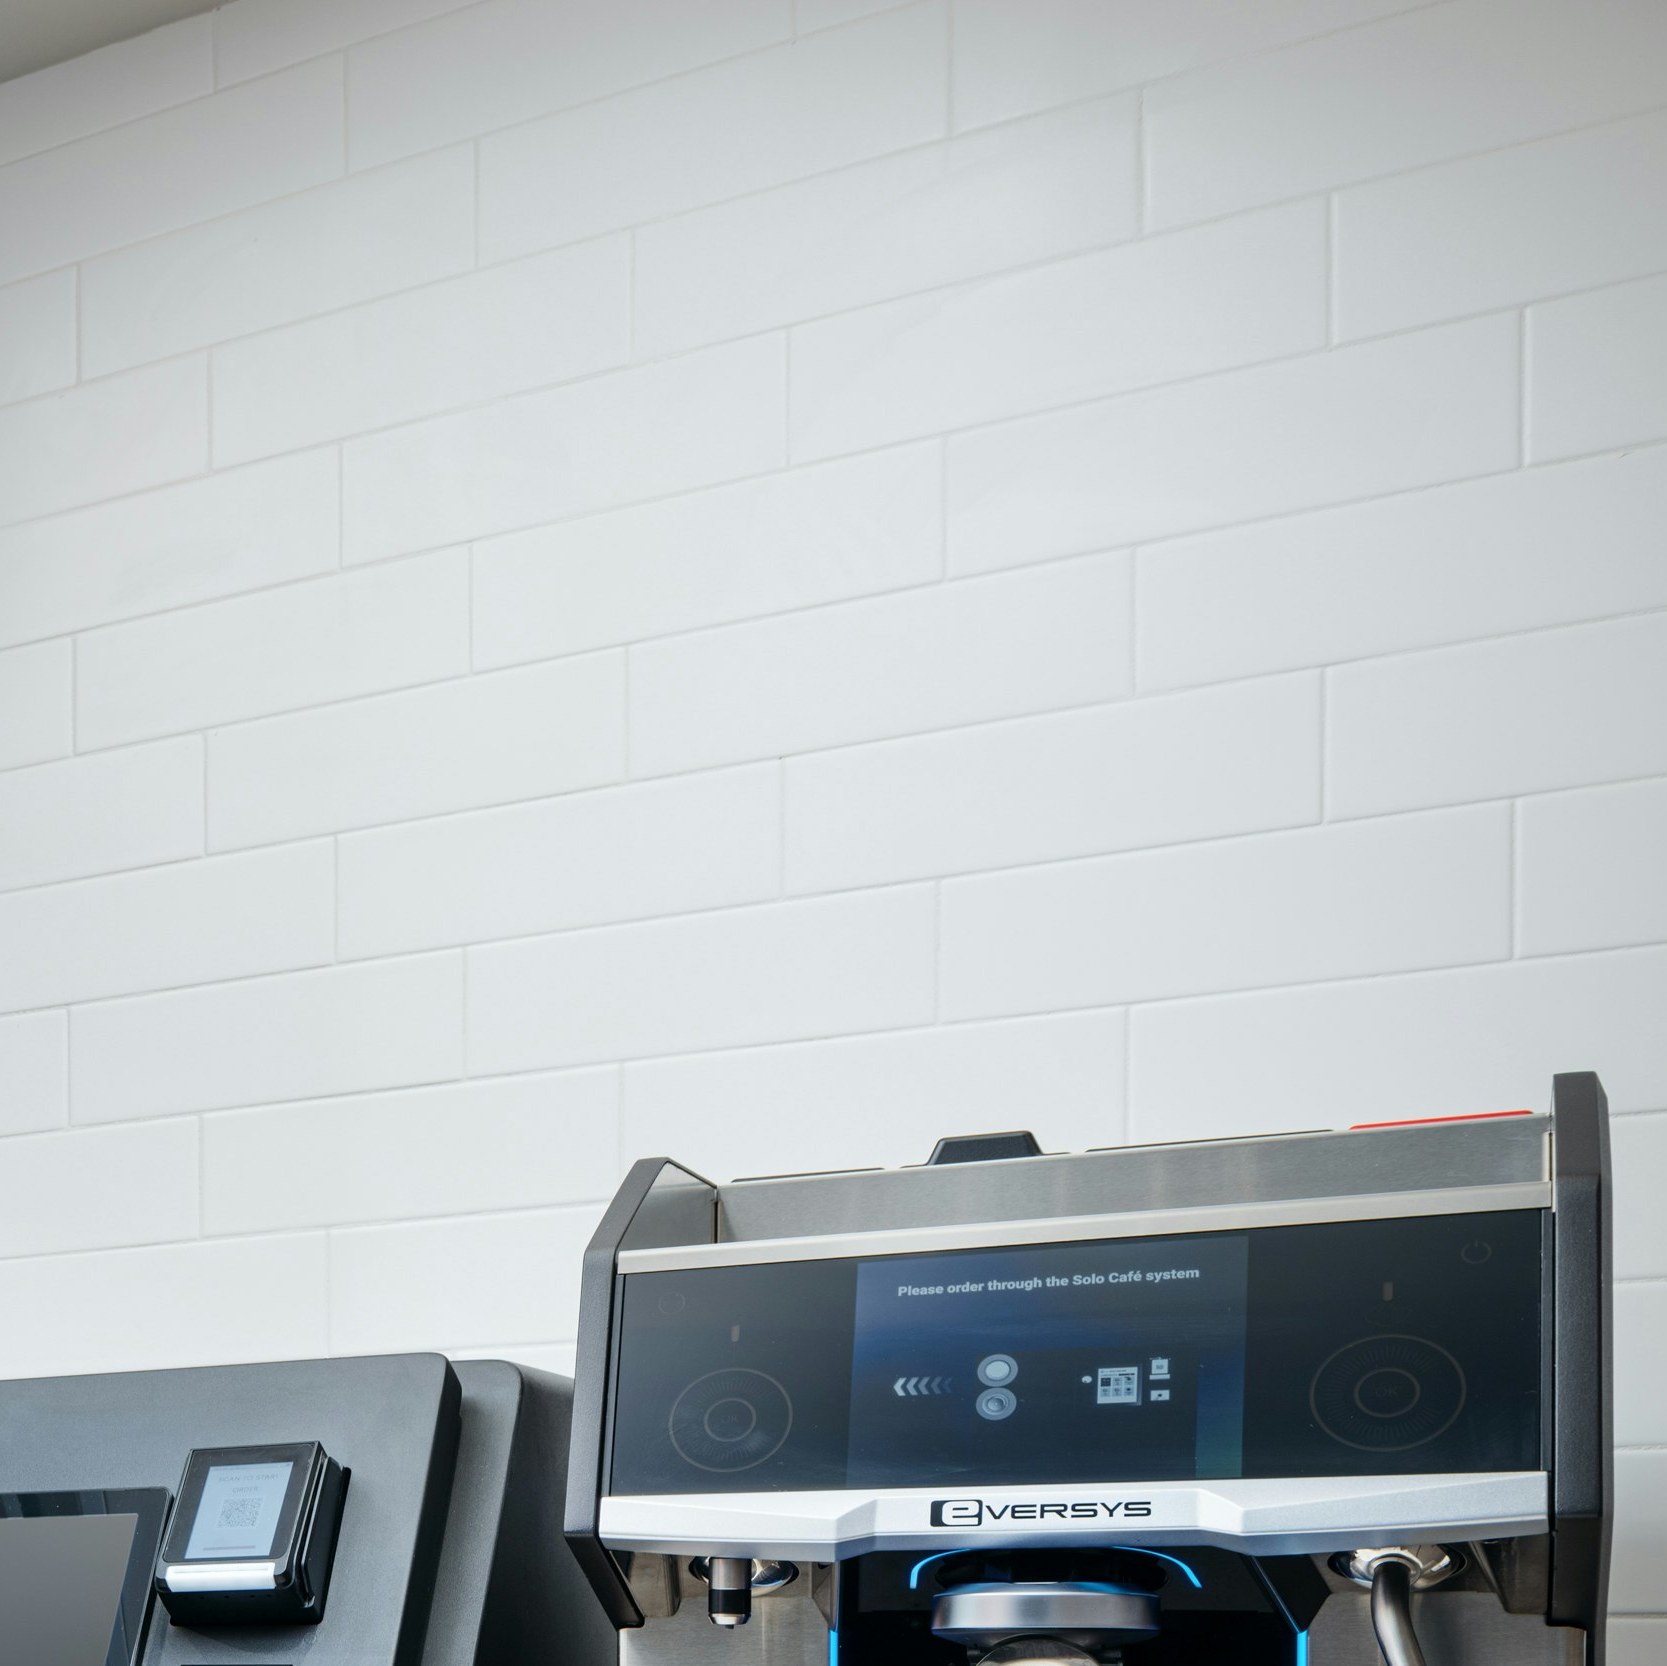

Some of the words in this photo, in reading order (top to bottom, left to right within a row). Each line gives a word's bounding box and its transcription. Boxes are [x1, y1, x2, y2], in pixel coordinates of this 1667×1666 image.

[897, 1284, 944, 1297] Please
[947, 1281, 984, 1294] order
[987, 1277, 1042, 1293] through
[1045, 1275, 1069, 1288] the
[1072, 1273, 1105, 1286] Solo
[1108, 1270, 1142, 1285] Café
[1145, 1268, 1200, 1283] system
[218, 1474, 240, 1482] SCAN
[232, 1485, 259, 1494] ORDER
